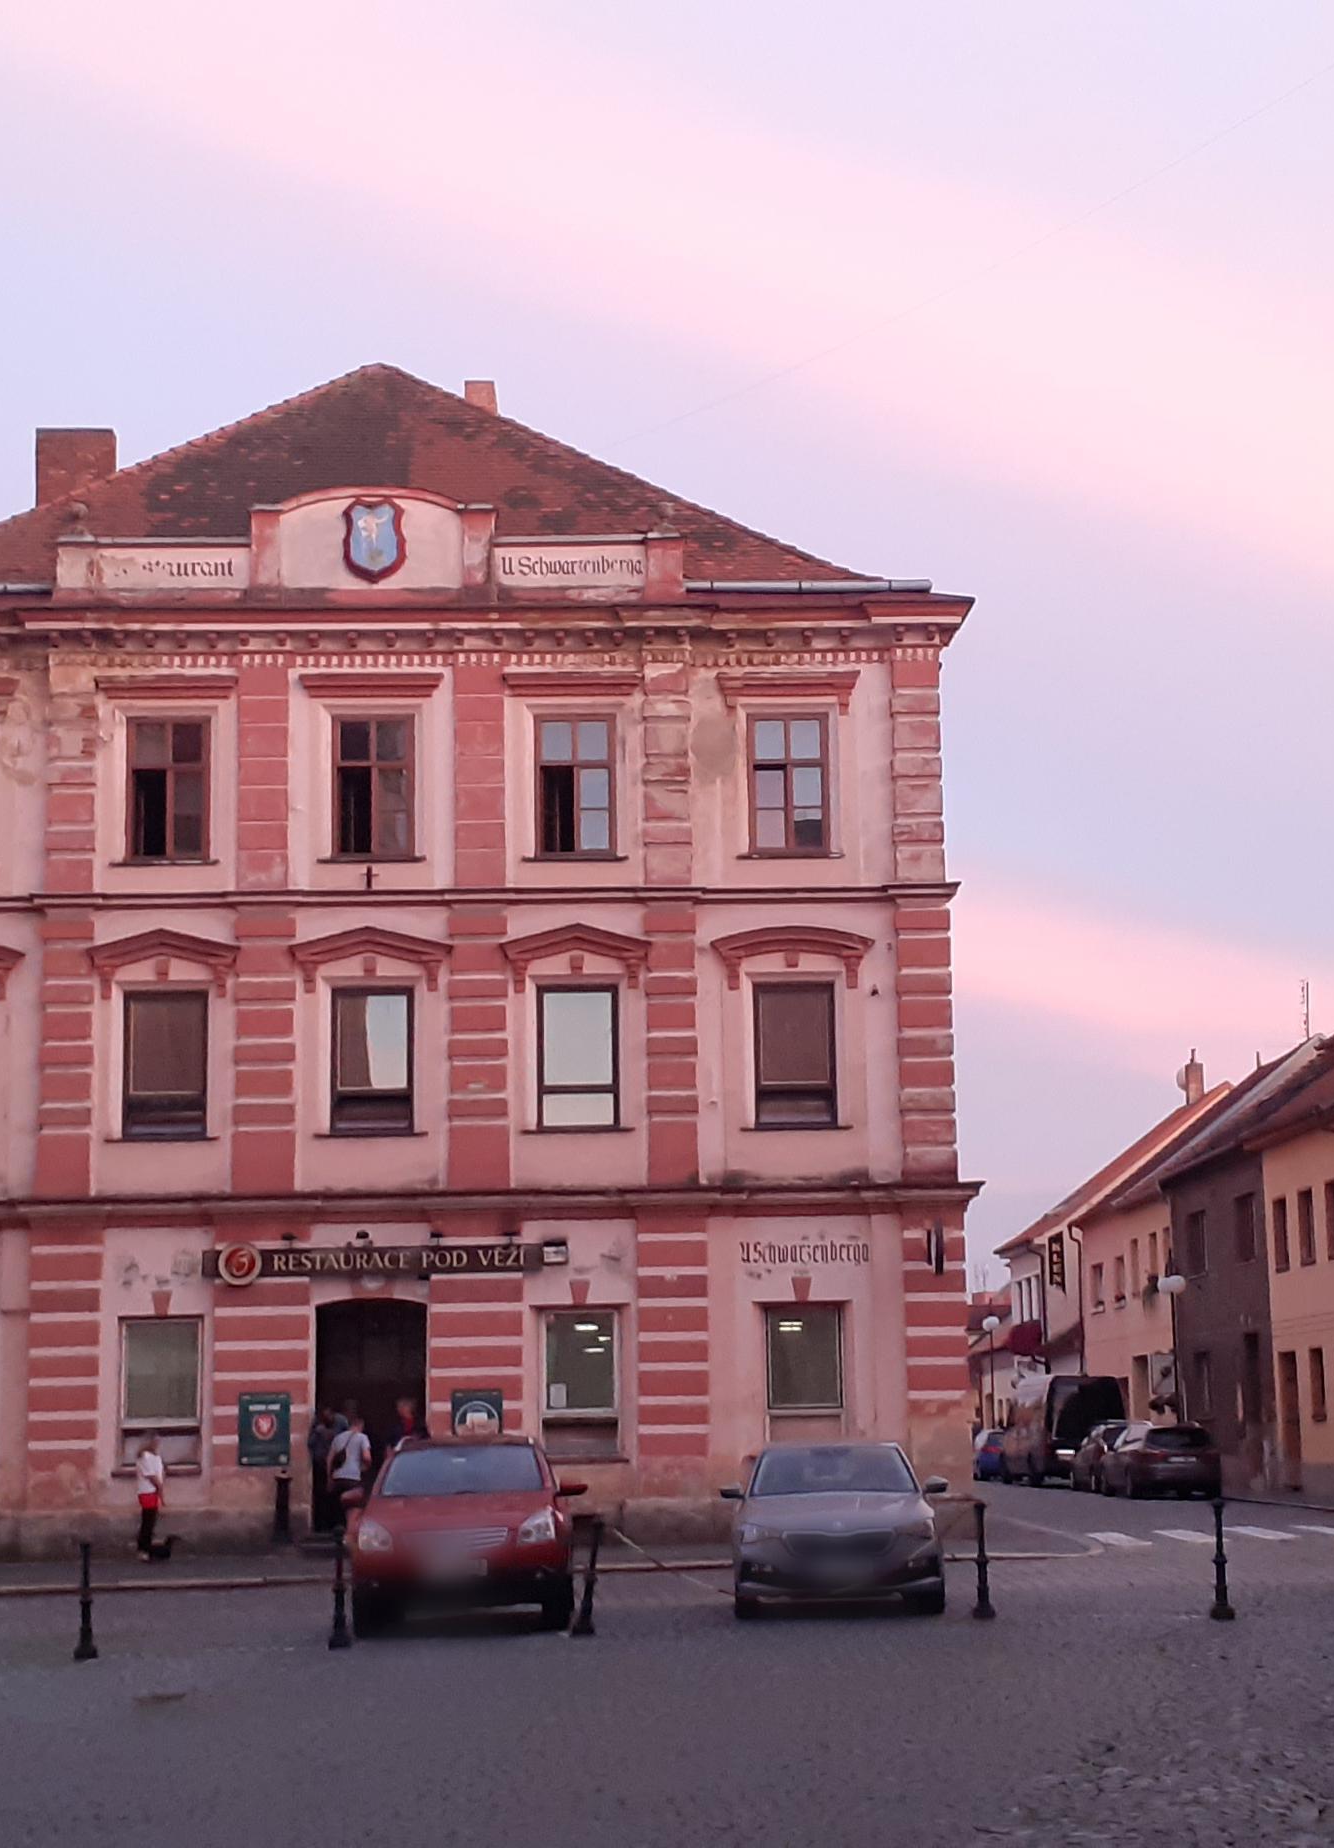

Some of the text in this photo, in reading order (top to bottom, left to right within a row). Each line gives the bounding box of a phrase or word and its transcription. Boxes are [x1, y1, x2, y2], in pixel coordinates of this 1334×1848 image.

[501, 556, 516, 576] U
[273, 1250, 410, 1272] RESTAURACE
[421, 1249, 468, 1269] POD
